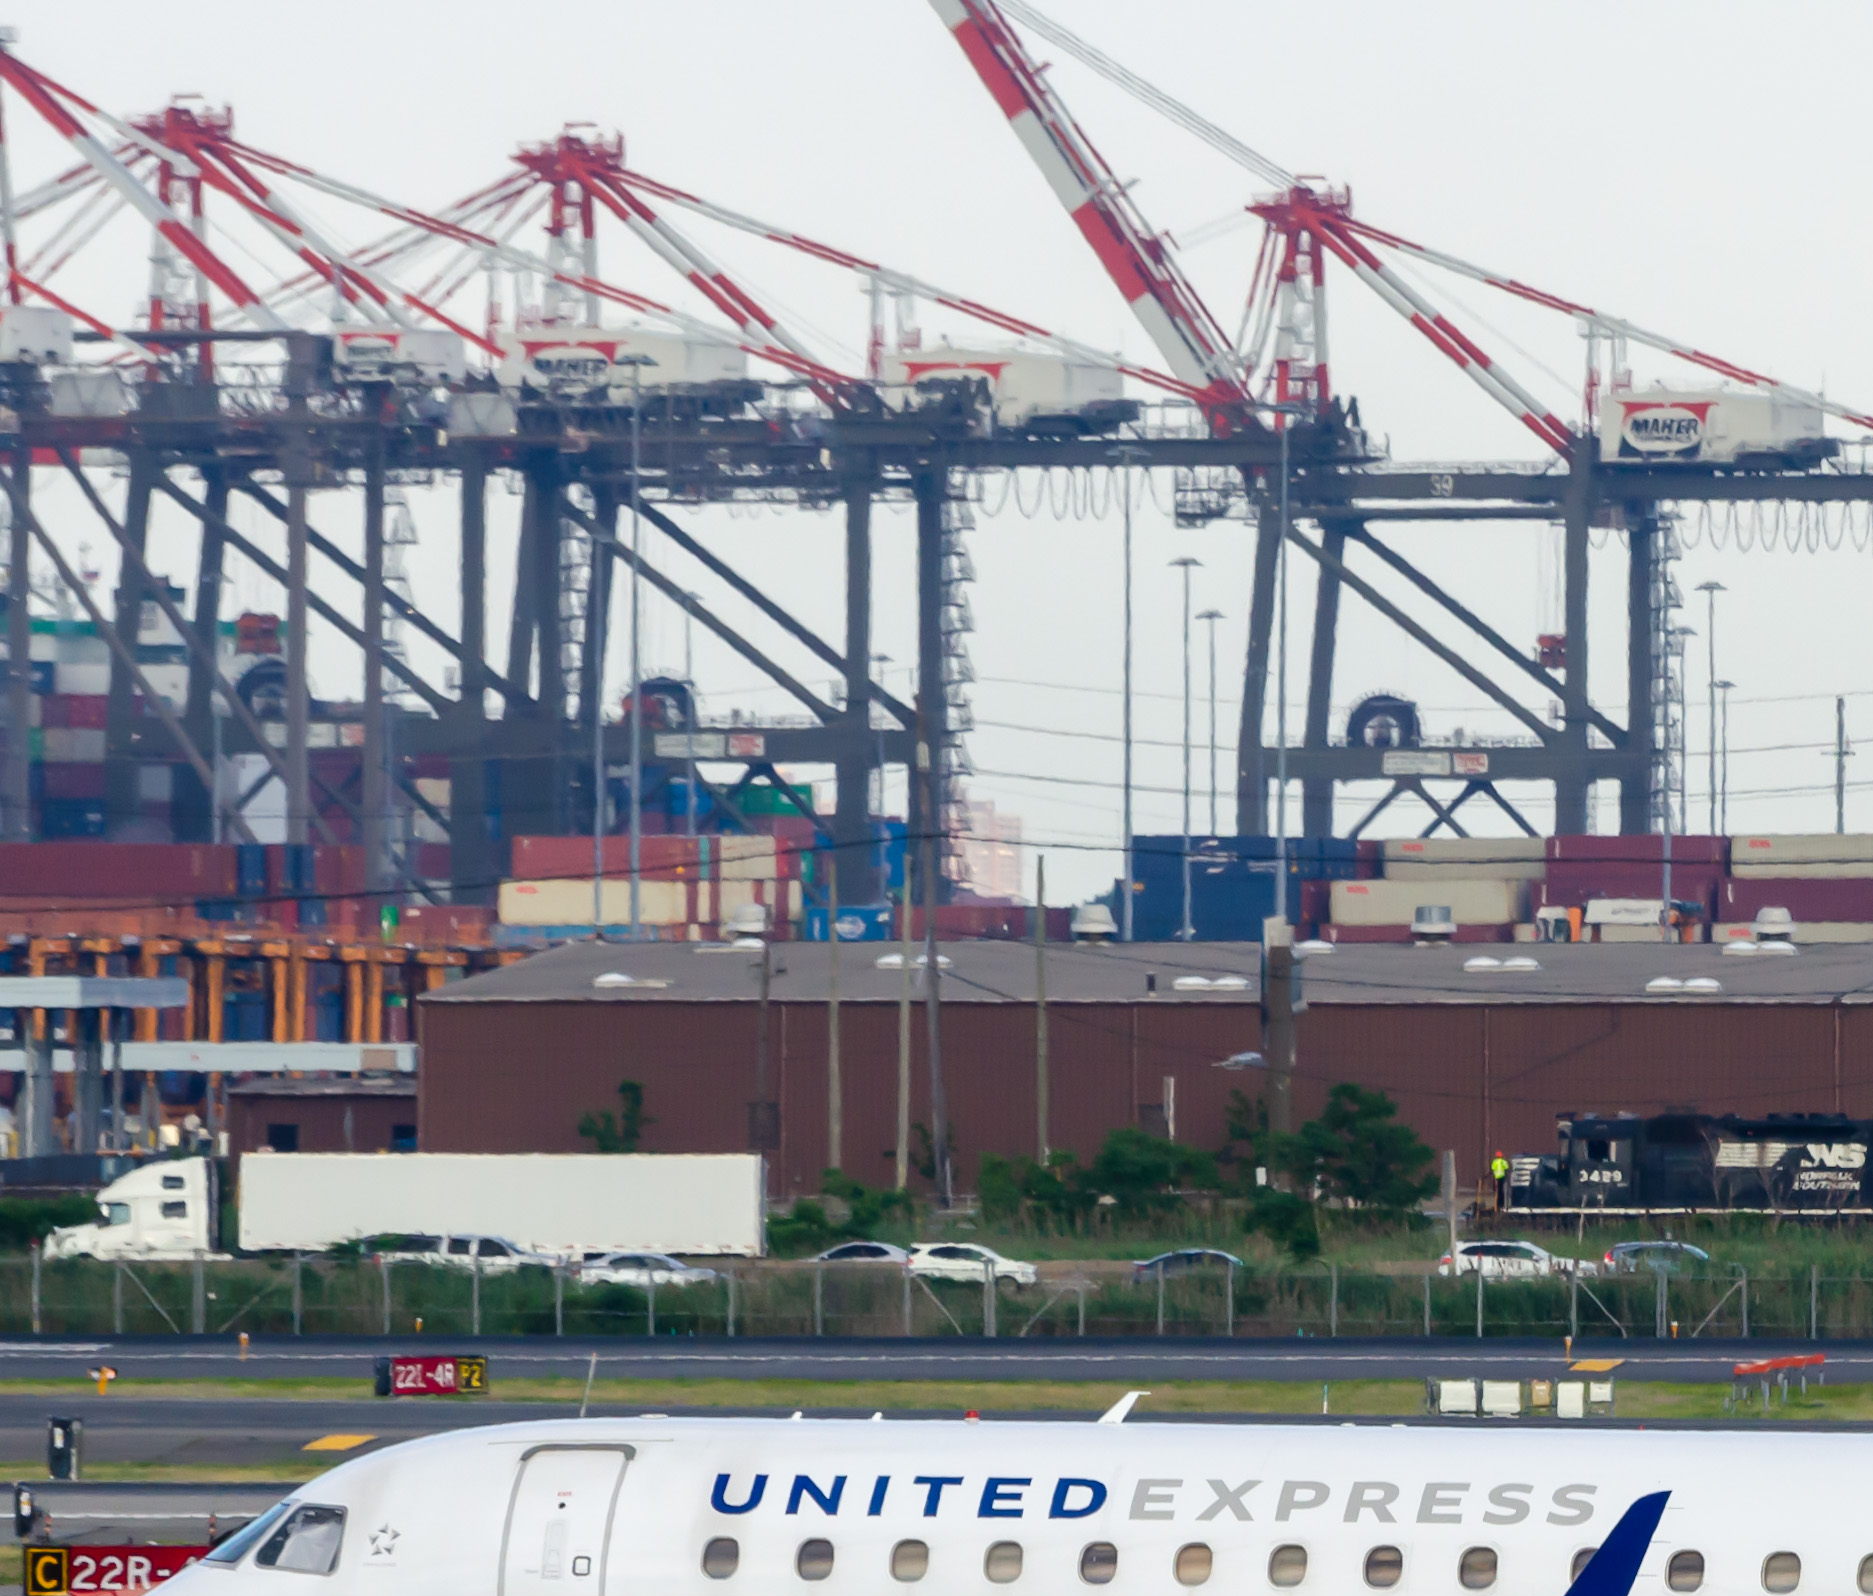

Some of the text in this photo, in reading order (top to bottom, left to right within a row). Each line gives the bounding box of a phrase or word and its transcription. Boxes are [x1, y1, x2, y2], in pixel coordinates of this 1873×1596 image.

[1630, 418, 1698, 434] MAHER
[712, 1474, 1598, 1526] UNITED EXPRESS
[35, 1555, 58, 1589] C
